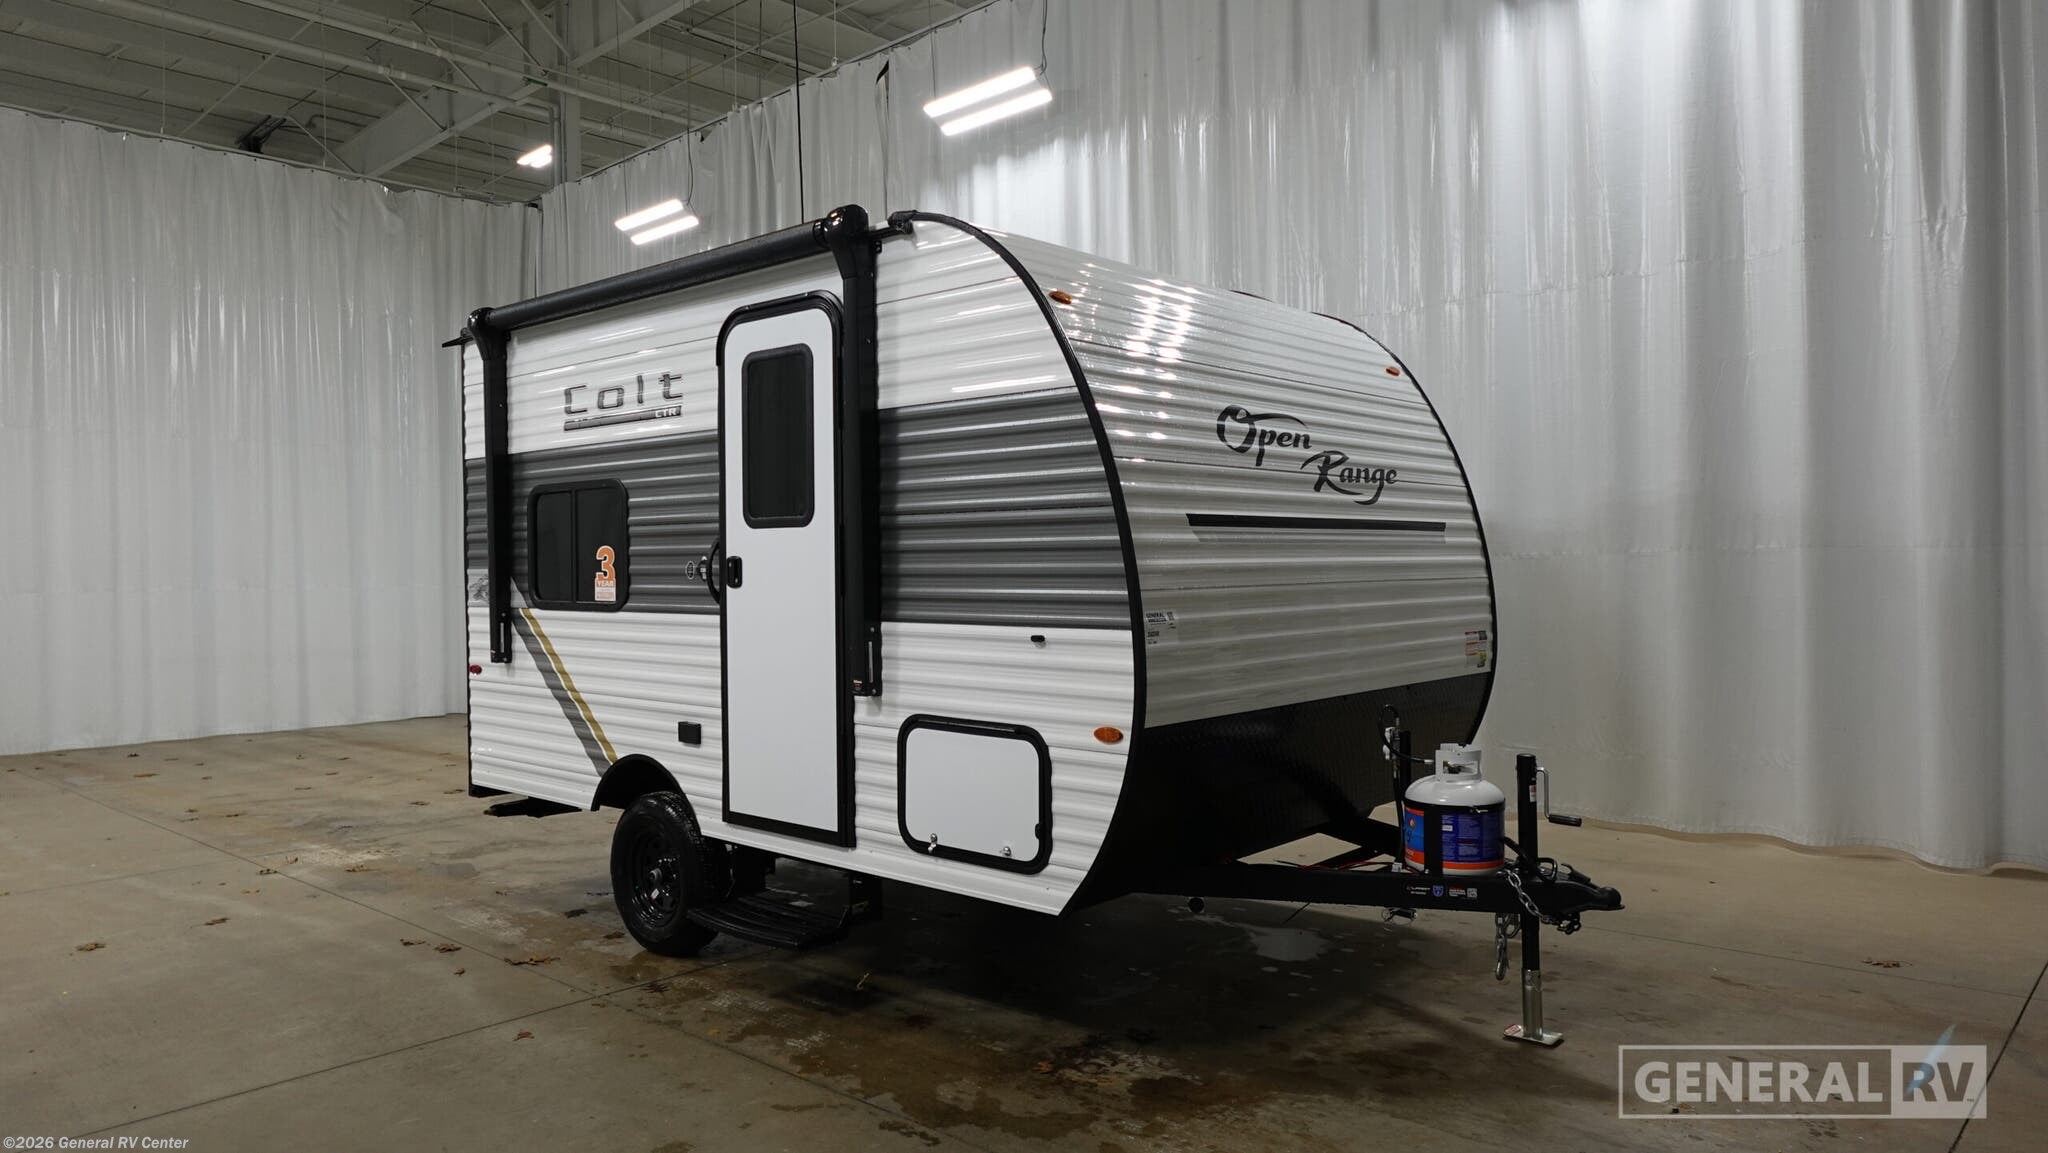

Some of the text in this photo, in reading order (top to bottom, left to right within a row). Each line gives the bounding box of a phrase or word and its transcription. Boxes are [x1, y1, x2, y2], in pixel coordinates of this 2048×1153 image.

[564, 373, 683, 415] Colt
[655, 407, 677, 418] CTR
[1216, 404, 1312, 467] Open
[1300, 450, 1397, 505] Range
[596, 545, 616, 581] 3
